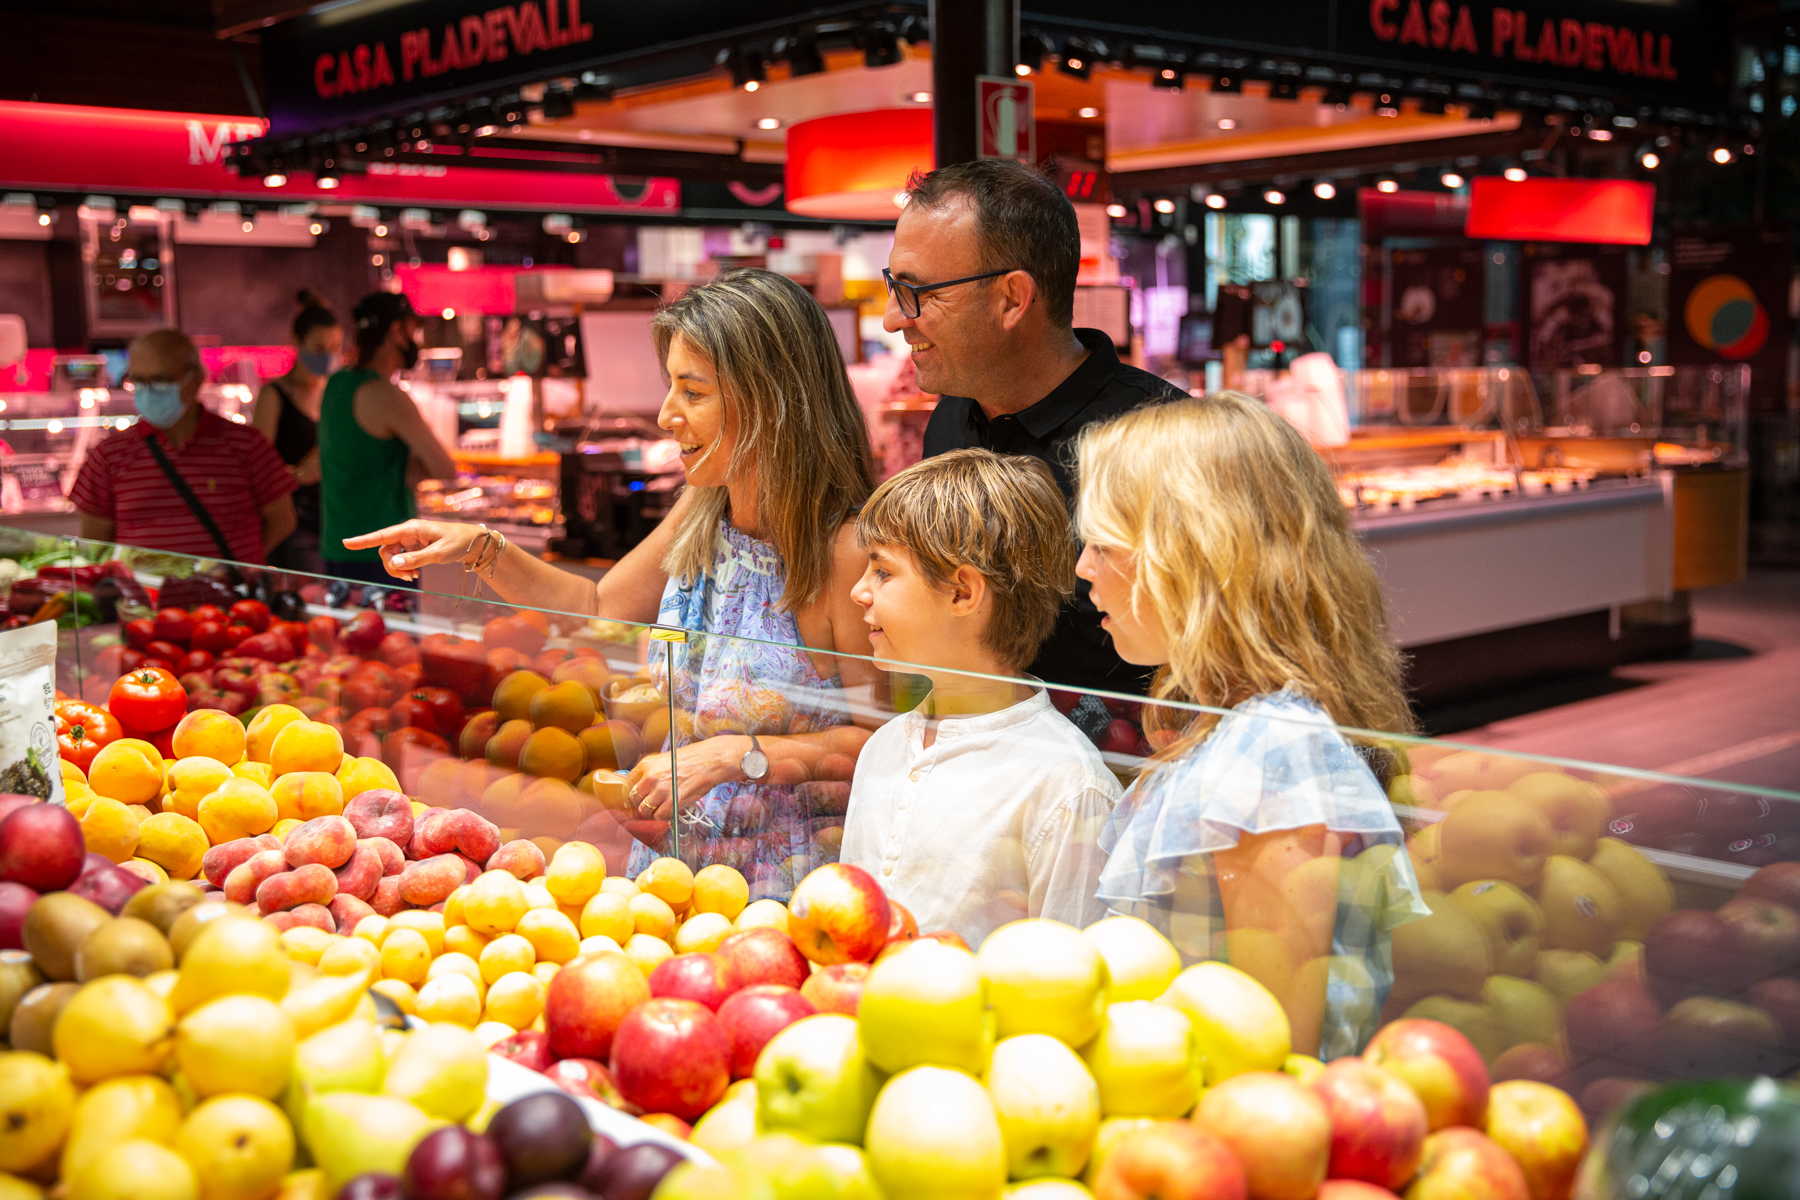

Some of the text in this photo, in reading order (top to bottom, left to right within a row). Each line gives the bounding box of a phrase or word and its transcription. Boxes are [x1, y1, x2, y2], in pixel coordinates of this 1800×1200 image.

[314, 0, 593, 98] CASA PLADEVALL
[1369, 0, 1678, 81] CASA PLADEVALL
